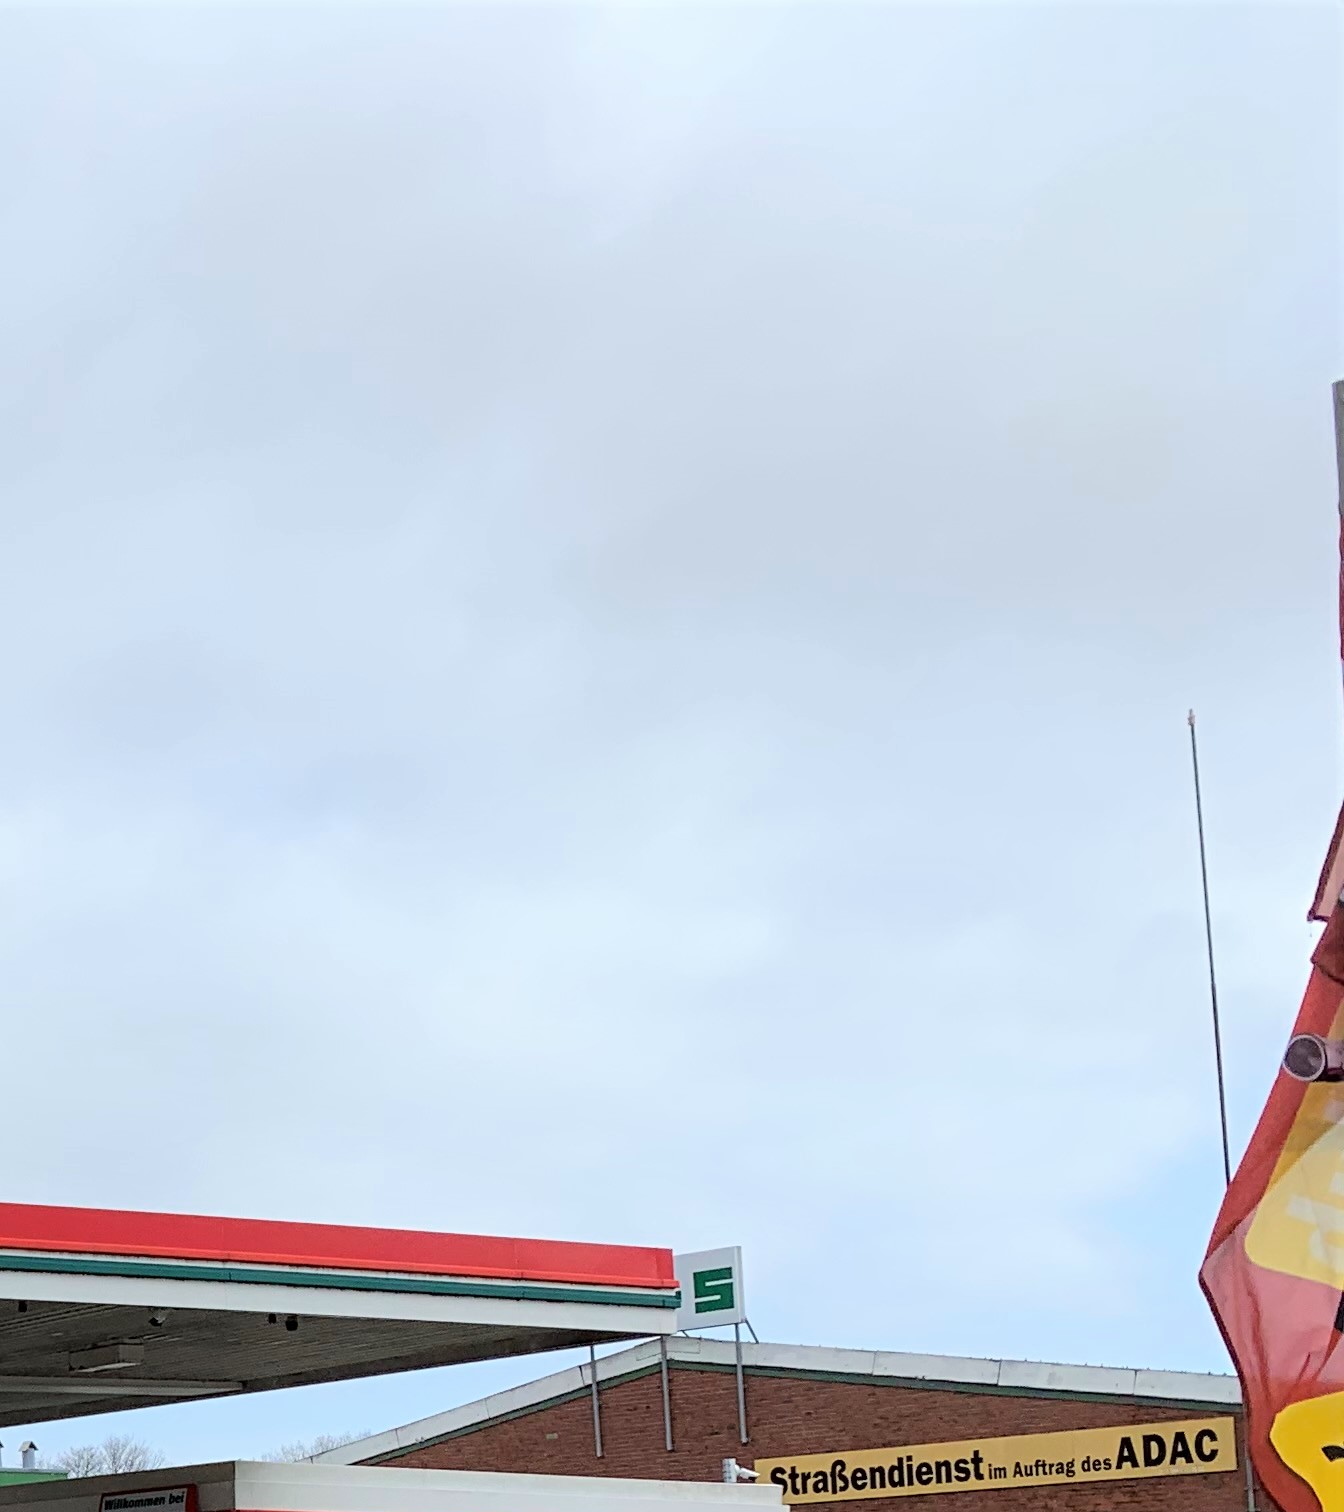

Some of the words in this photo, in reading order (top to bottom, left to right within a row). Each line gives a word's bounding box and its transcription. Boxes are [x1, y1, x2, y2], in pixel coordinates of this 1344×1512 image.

[770, 1449, 985, 1496] Straßendienst
[988, 1463, 1007, 1480] im
[1013, 1458, 1076, 1479] Auftrag
[1081, 1455, 1112, 1474] des
[1115, 1429, 1219, 1470] ADAC
[104, 1496, 166, 1511] Willkommen
[168, 1491, 185, 1505] bei
